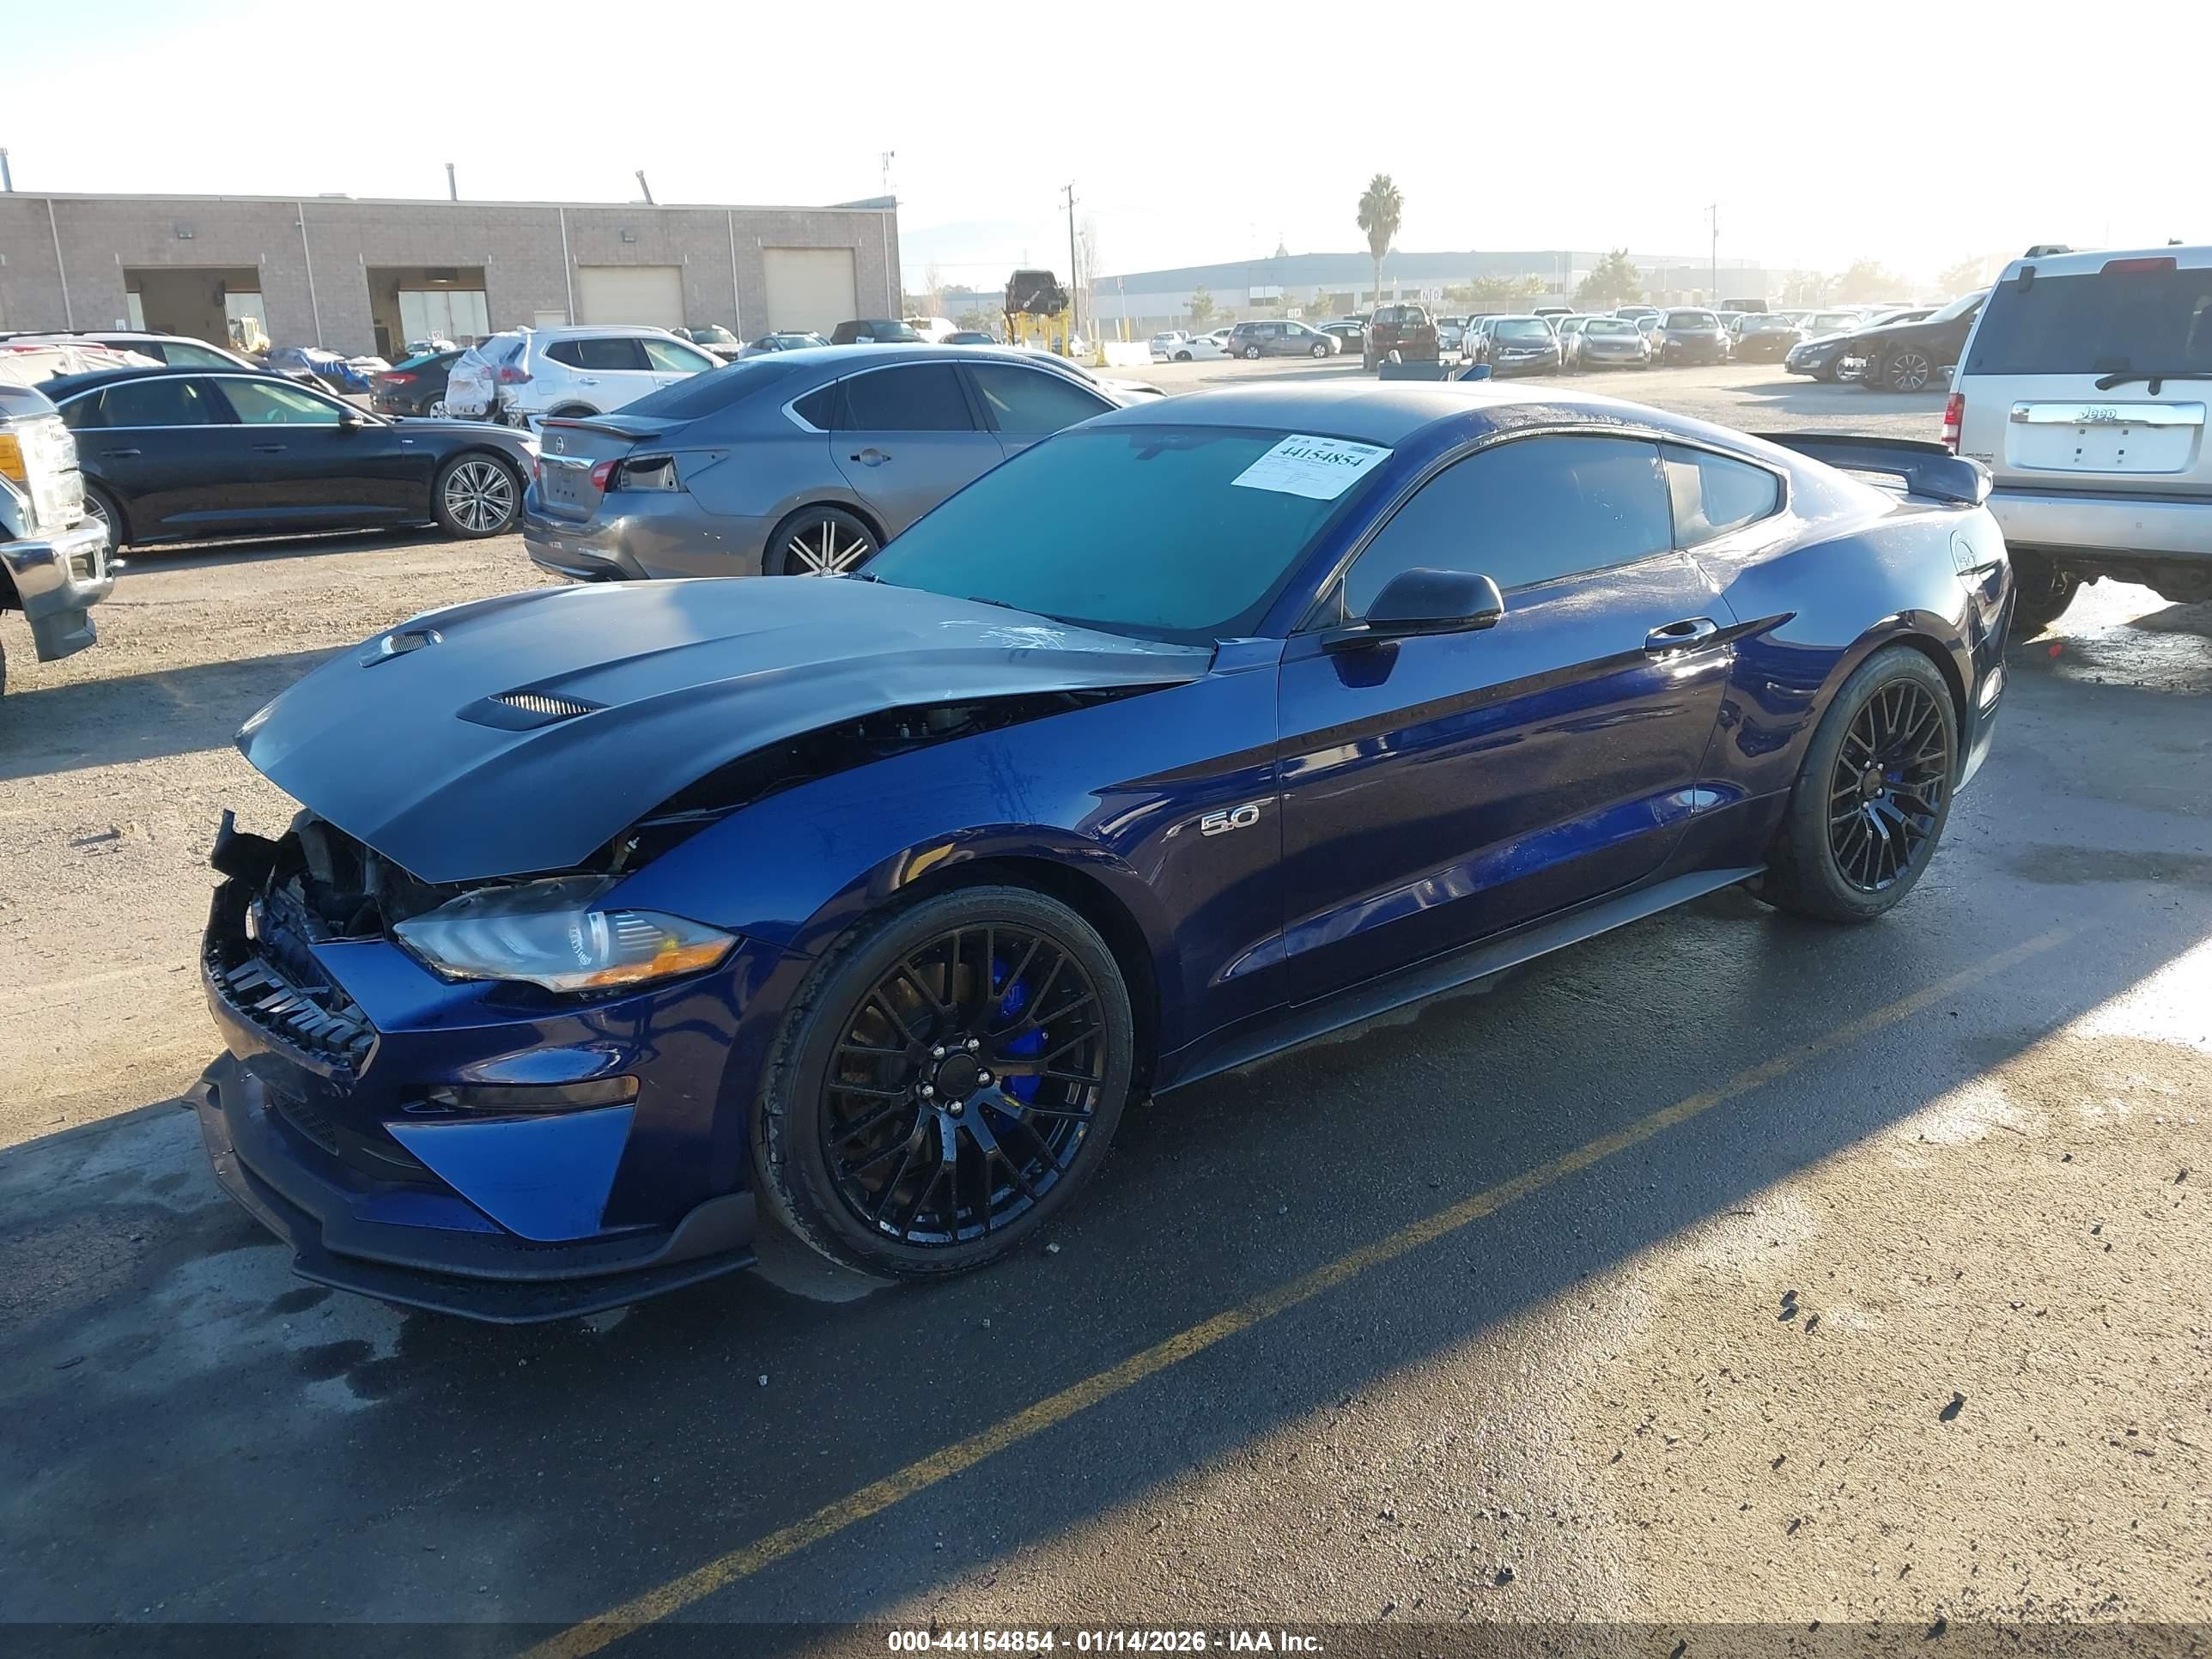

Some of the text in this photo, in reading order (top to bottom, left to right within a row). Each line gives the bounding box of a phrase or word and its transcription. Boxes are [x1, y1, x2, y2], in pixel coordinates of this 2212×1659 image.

[2079, 406, 2117, 421] Jeep
[1279, 445, 1366, 468] 44154854
[1200, 805, 1260, 837] 5.0
